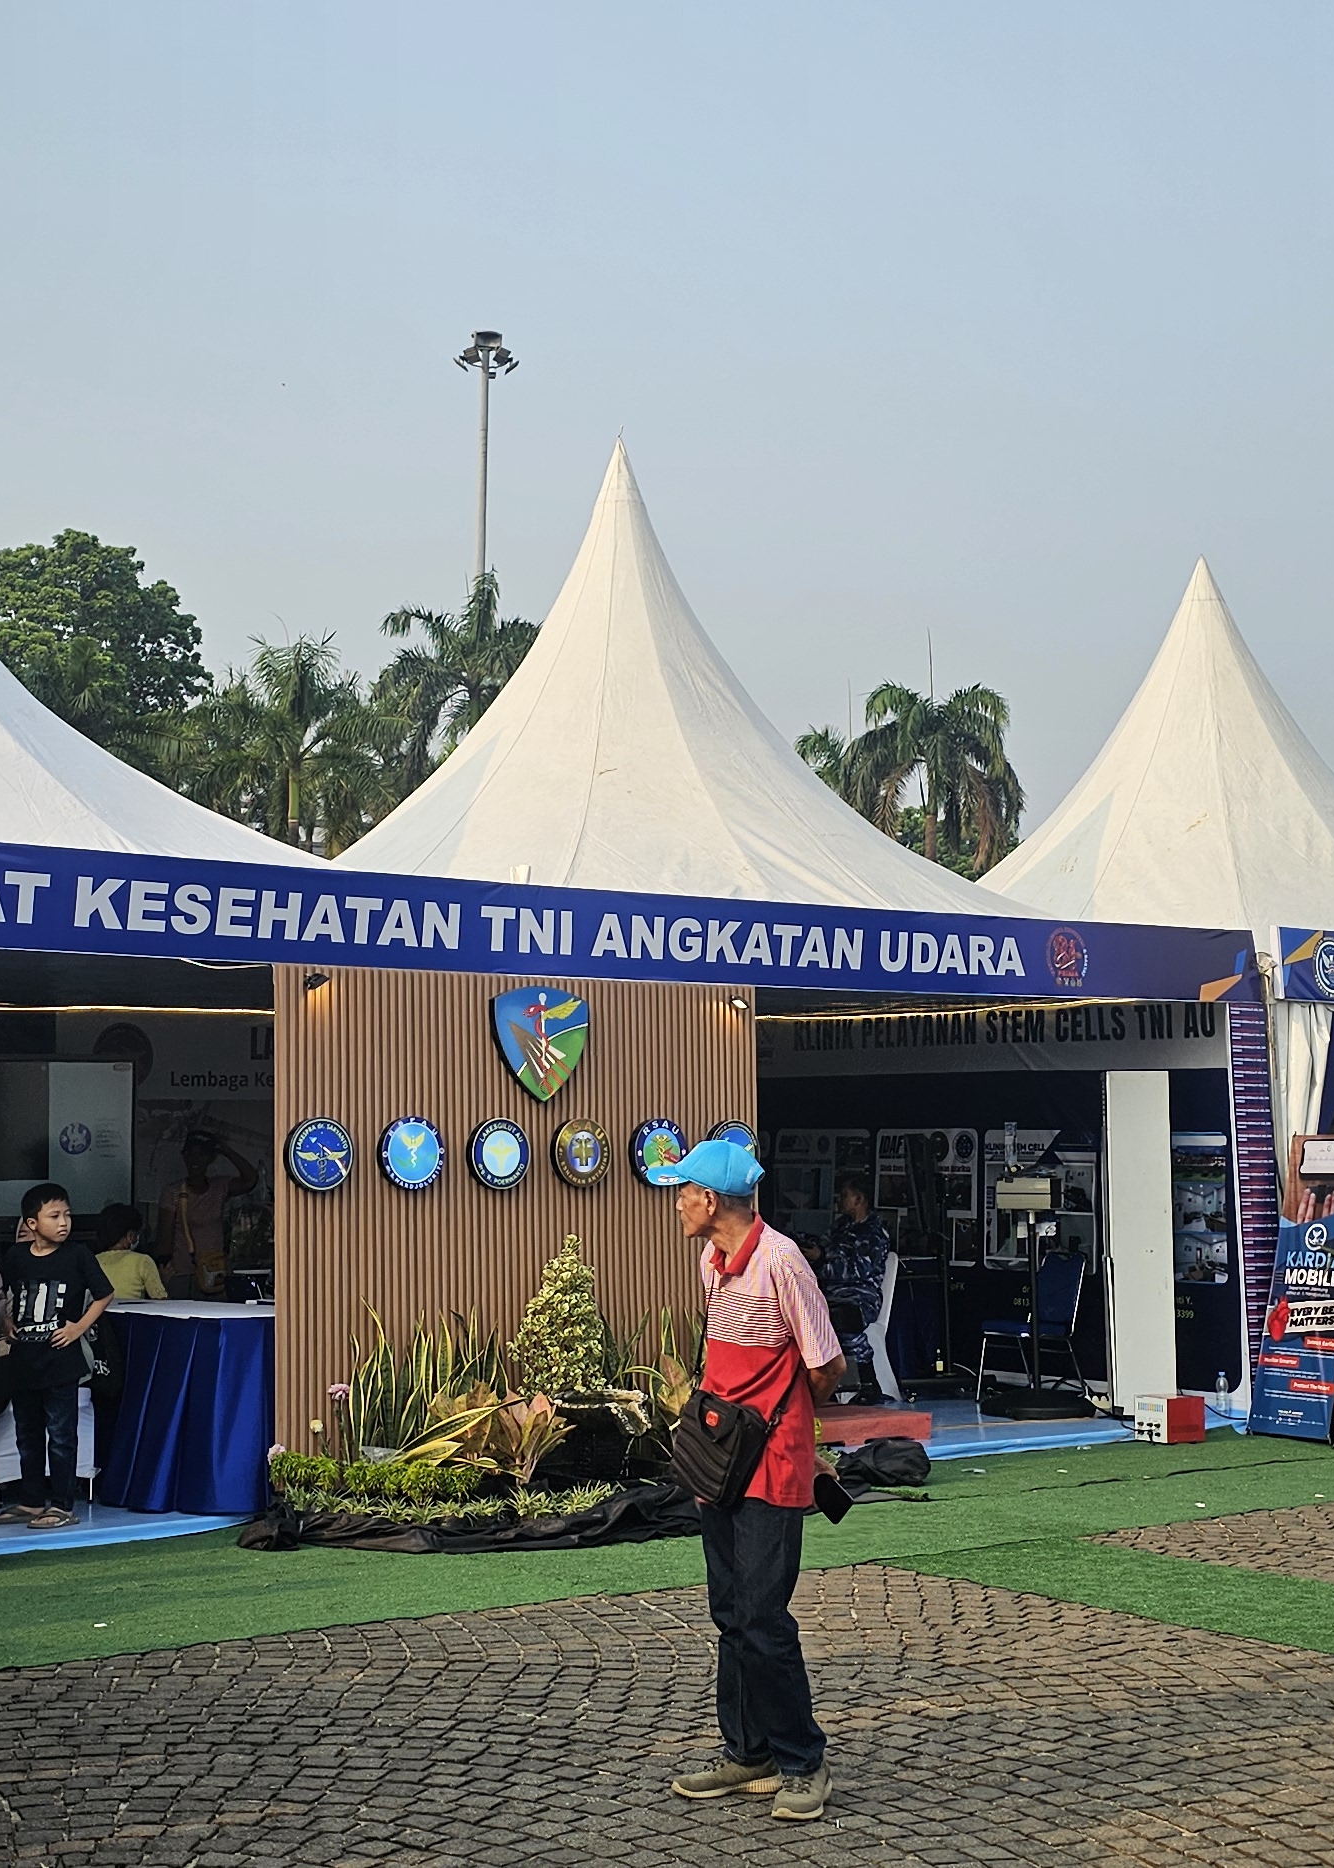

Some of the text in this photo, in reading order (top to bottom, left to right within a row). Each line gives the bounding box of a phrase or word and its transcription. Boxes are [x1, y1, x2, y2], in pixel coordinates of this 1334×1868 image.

[73, 876, 460, 950] KESEHATAN
[480, 905, 573, 955] TNI
[591, 913, 864, 971] ANGKATAN
[879, 930, 1026, 977] UDARA
[795, 1002, 1216, 1050] KLINIK PELAYANAN STEM CELLS TNI AU
[171, 1071, 249, 1091] Lembaga
[562, 1121, 605, 1143] RSAU
[642, 1120, 680, 1136] RSAU
[1289, 1316, 1334, 1327] MATTERS
[1290, 1306, 1321, 1317] EVERY
